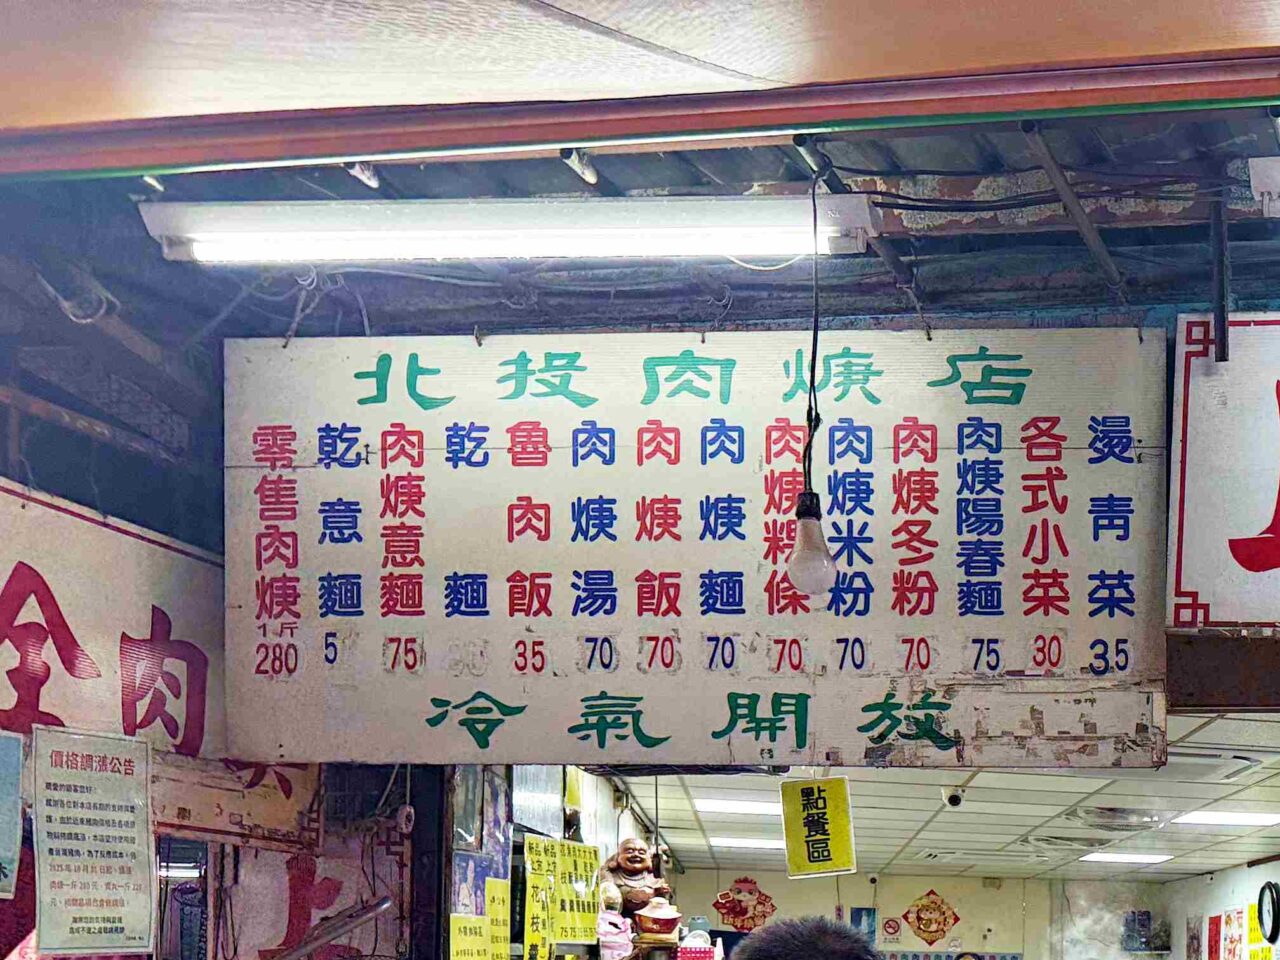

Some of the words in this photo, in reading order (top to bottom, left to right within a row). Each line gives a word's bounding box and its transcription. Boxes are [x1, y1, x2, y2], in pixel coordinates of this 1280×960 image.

[254, 642, 298, 677] 280
[386, 637, 418, 671] 75
[514, 639, 546, 673] 35
[584, 636, 614, 671] 70
[646, 635, 675, 670] 70
[706, 635, 736, 670] 70
[773, 637, 804, 672] 70
[835, 636, 866, 671] 70
[900, 636, 932, 671] 70
[971, 638, 1001, 672] 75
[1032, 633, 1063, 669] 30
[1088, 637, 1130, 677] 35
[426, 690, 960, 751] 冷氣開放
[800, 784, 833, 864] 點餐區
